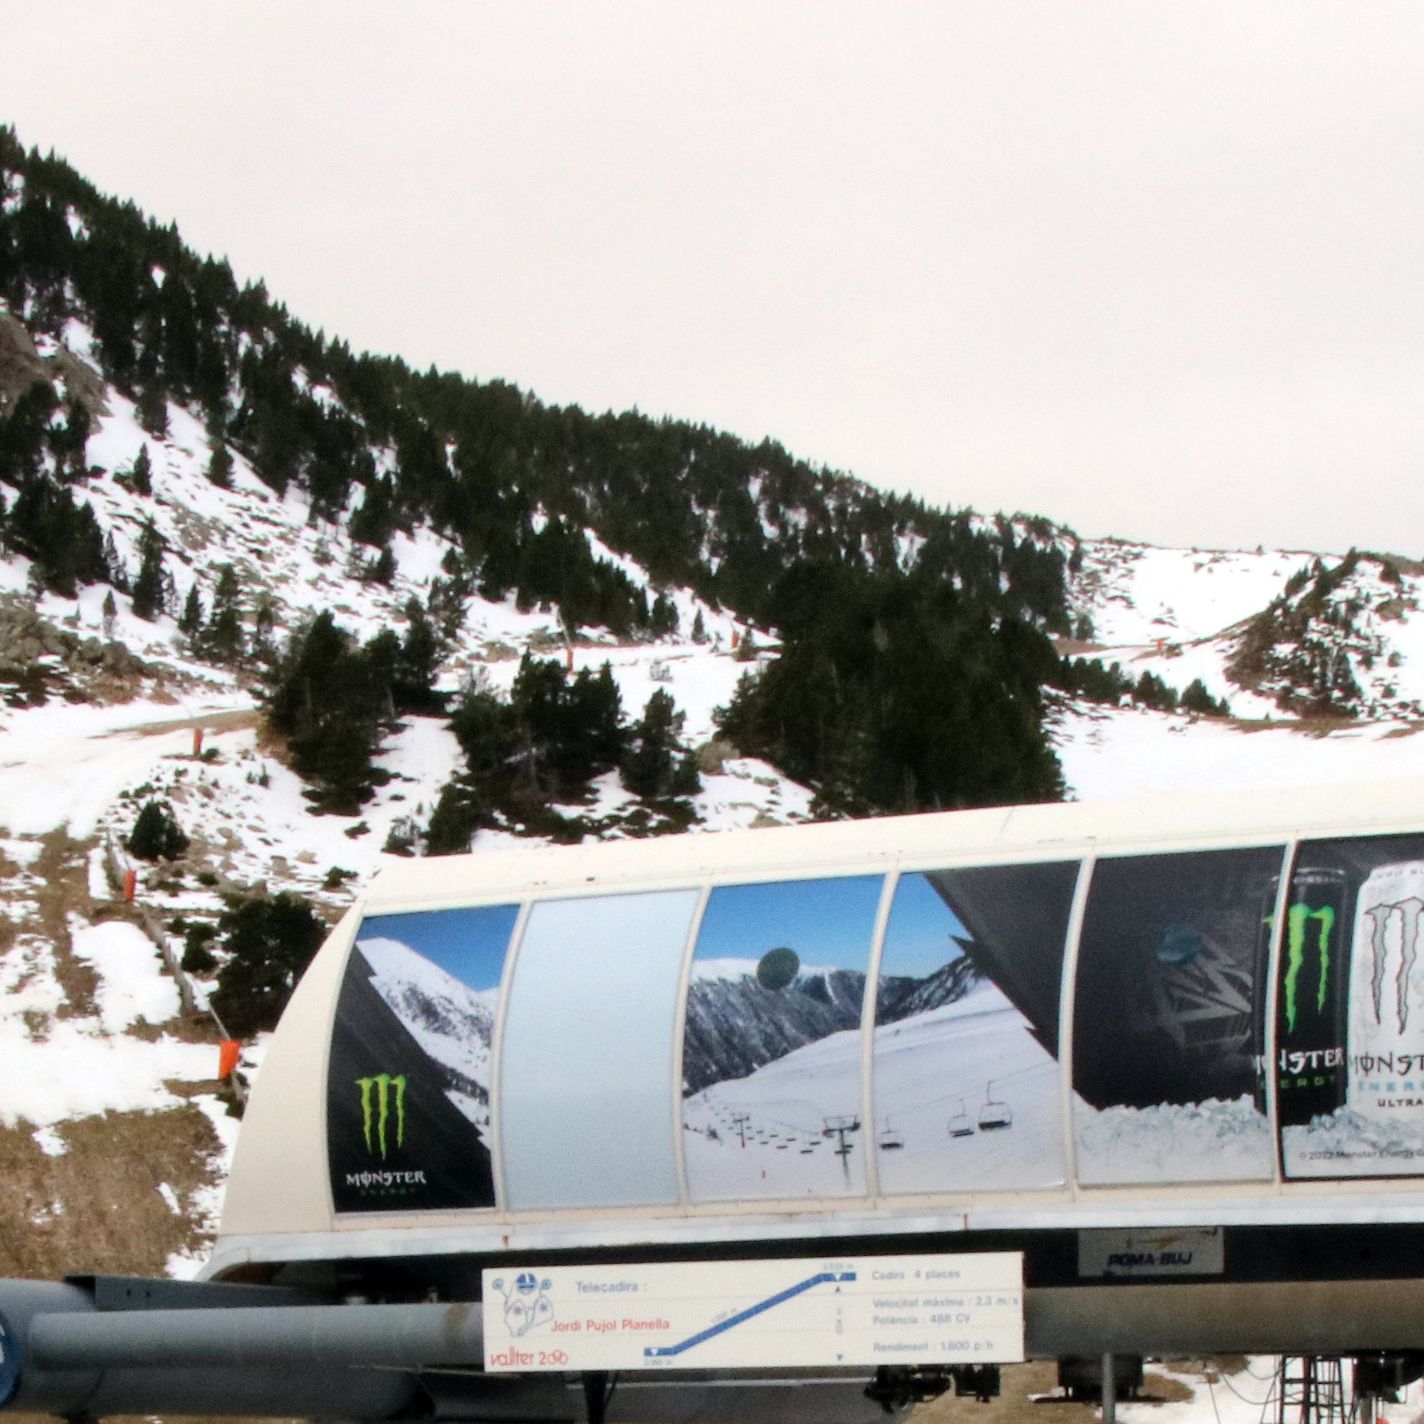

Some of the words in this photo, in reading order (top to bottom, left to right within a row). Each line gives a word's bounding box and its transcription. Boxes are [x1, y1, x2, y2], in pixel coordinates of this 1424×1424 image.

[346, 1170, 426, 1187] MONSTER
[871, 1270, 905, 1280] Cadira
[914, 1270, 921, 1279] 4
[925, 1269, 961, 1280] places
[576, 1281, 638, 1293] Telecadira
[873, 1298, 918, 1309] Velocitat
[551, 1319, 581, 1333] Jordi
[586, 1319, 617, 1333] Pujol
[622, 1318, 671, 1331] Planella
